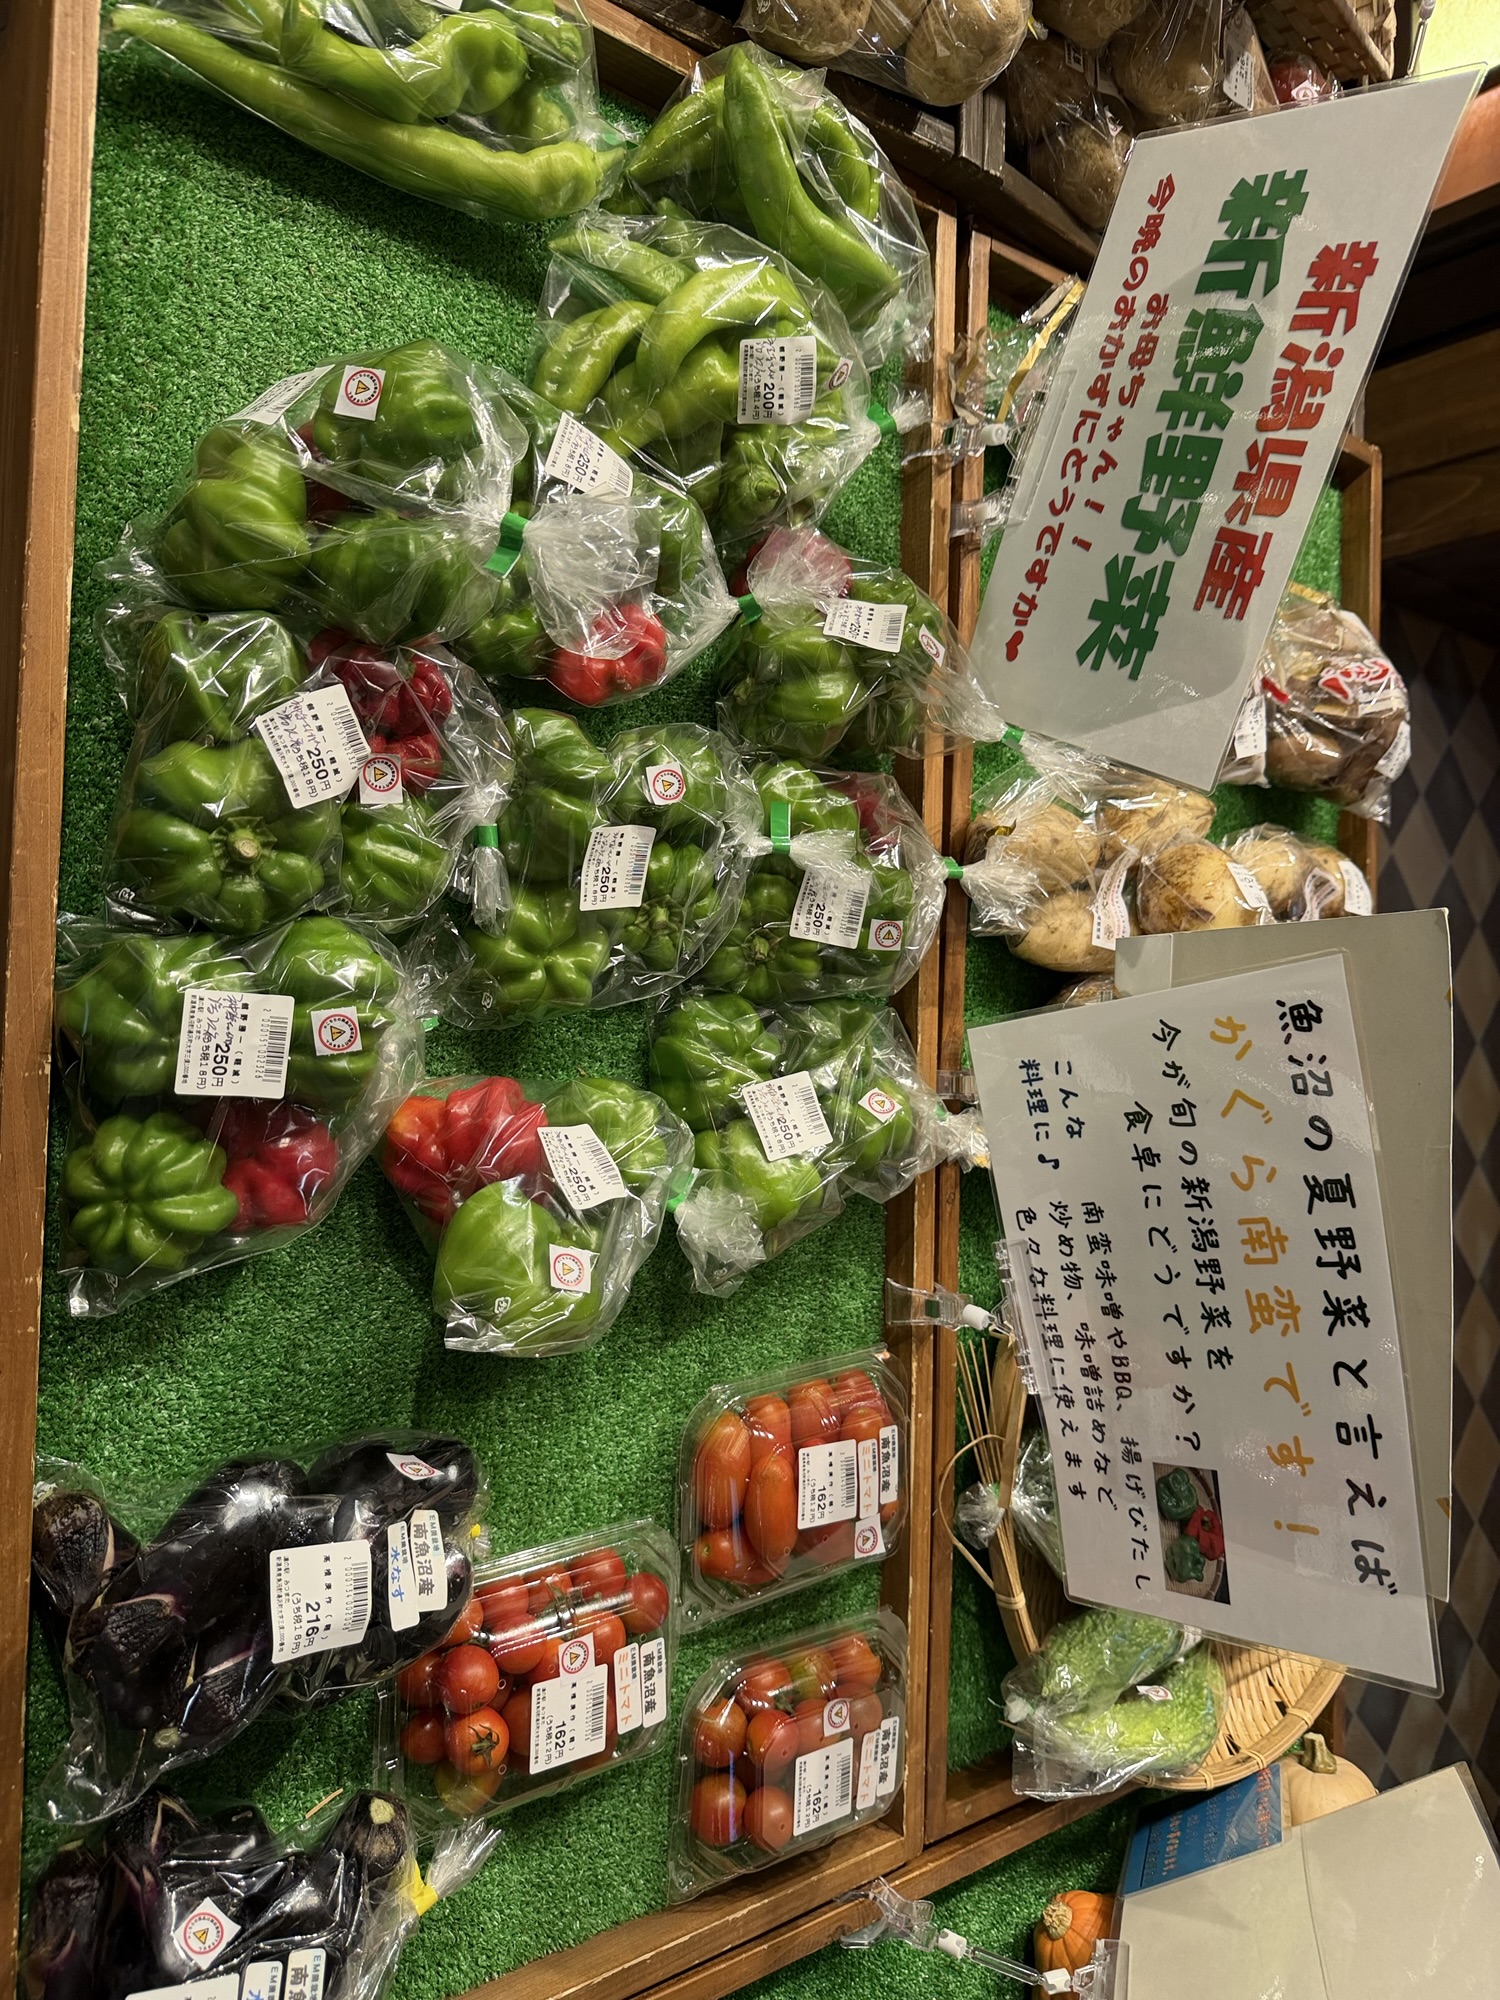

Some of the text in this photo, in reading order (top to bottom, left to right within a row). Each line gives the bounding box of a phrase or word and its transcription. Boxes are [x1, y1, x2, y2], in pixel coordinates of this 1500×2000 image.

[763, 382, 775, 418] 200円
[1070, 293, 1171, 553] お母ちゃん！！
[1076, 169, 1309, 682] 新鮮野菜
[1193, 240, 1380, 621] 新潟県産
[573, 454, 590, 483] 250円
[306, 747, 332, 791] 250円
[599, 866, 611, 903] 250円
[813, 903, 826, 935] 250円
[211, 1043, 230, 1087] 250円
[1054, 1061, 1086, 1139] こんな
[776, 1118, 795, 1148] 250円
[569, 1167, 589, 1201] 250円
[1151, 1019, 1234, 1371] 今が旬の新潟野菜を
[1122, 1101, 1201, 1451] 食卓にどうですか？
[1209, 1016, 1320, 1536] かぐら南蛮です！
[1276, 999, 1398, 1595] 魚沼の夏野菜と言えば
[1015, 1206, 1087, 1504] 色々な料理に使えます
[862, 1446, 872, 1512] ミニトマト
[881, 1436, 891, 1492] 南魚沼産
[817, 1485, 826, 1519] 162円
[391, 1546, 404, 1602] 水なす
[414, 1522, 435, 1596] 南魚沼産
[304, 1601, 321, 1648] 216円
[618, 1652, 632, 1725] ミニトマト
[643, 1651, 657, 1715] 南魚沼産
[555, 1721, 566, 1759] 162円
[878, 1727, 891, 1784] 南魚沼産
[861, 1736, 874, 1802] ミニトマト
[812, 1788, 821, 1823] 162円
